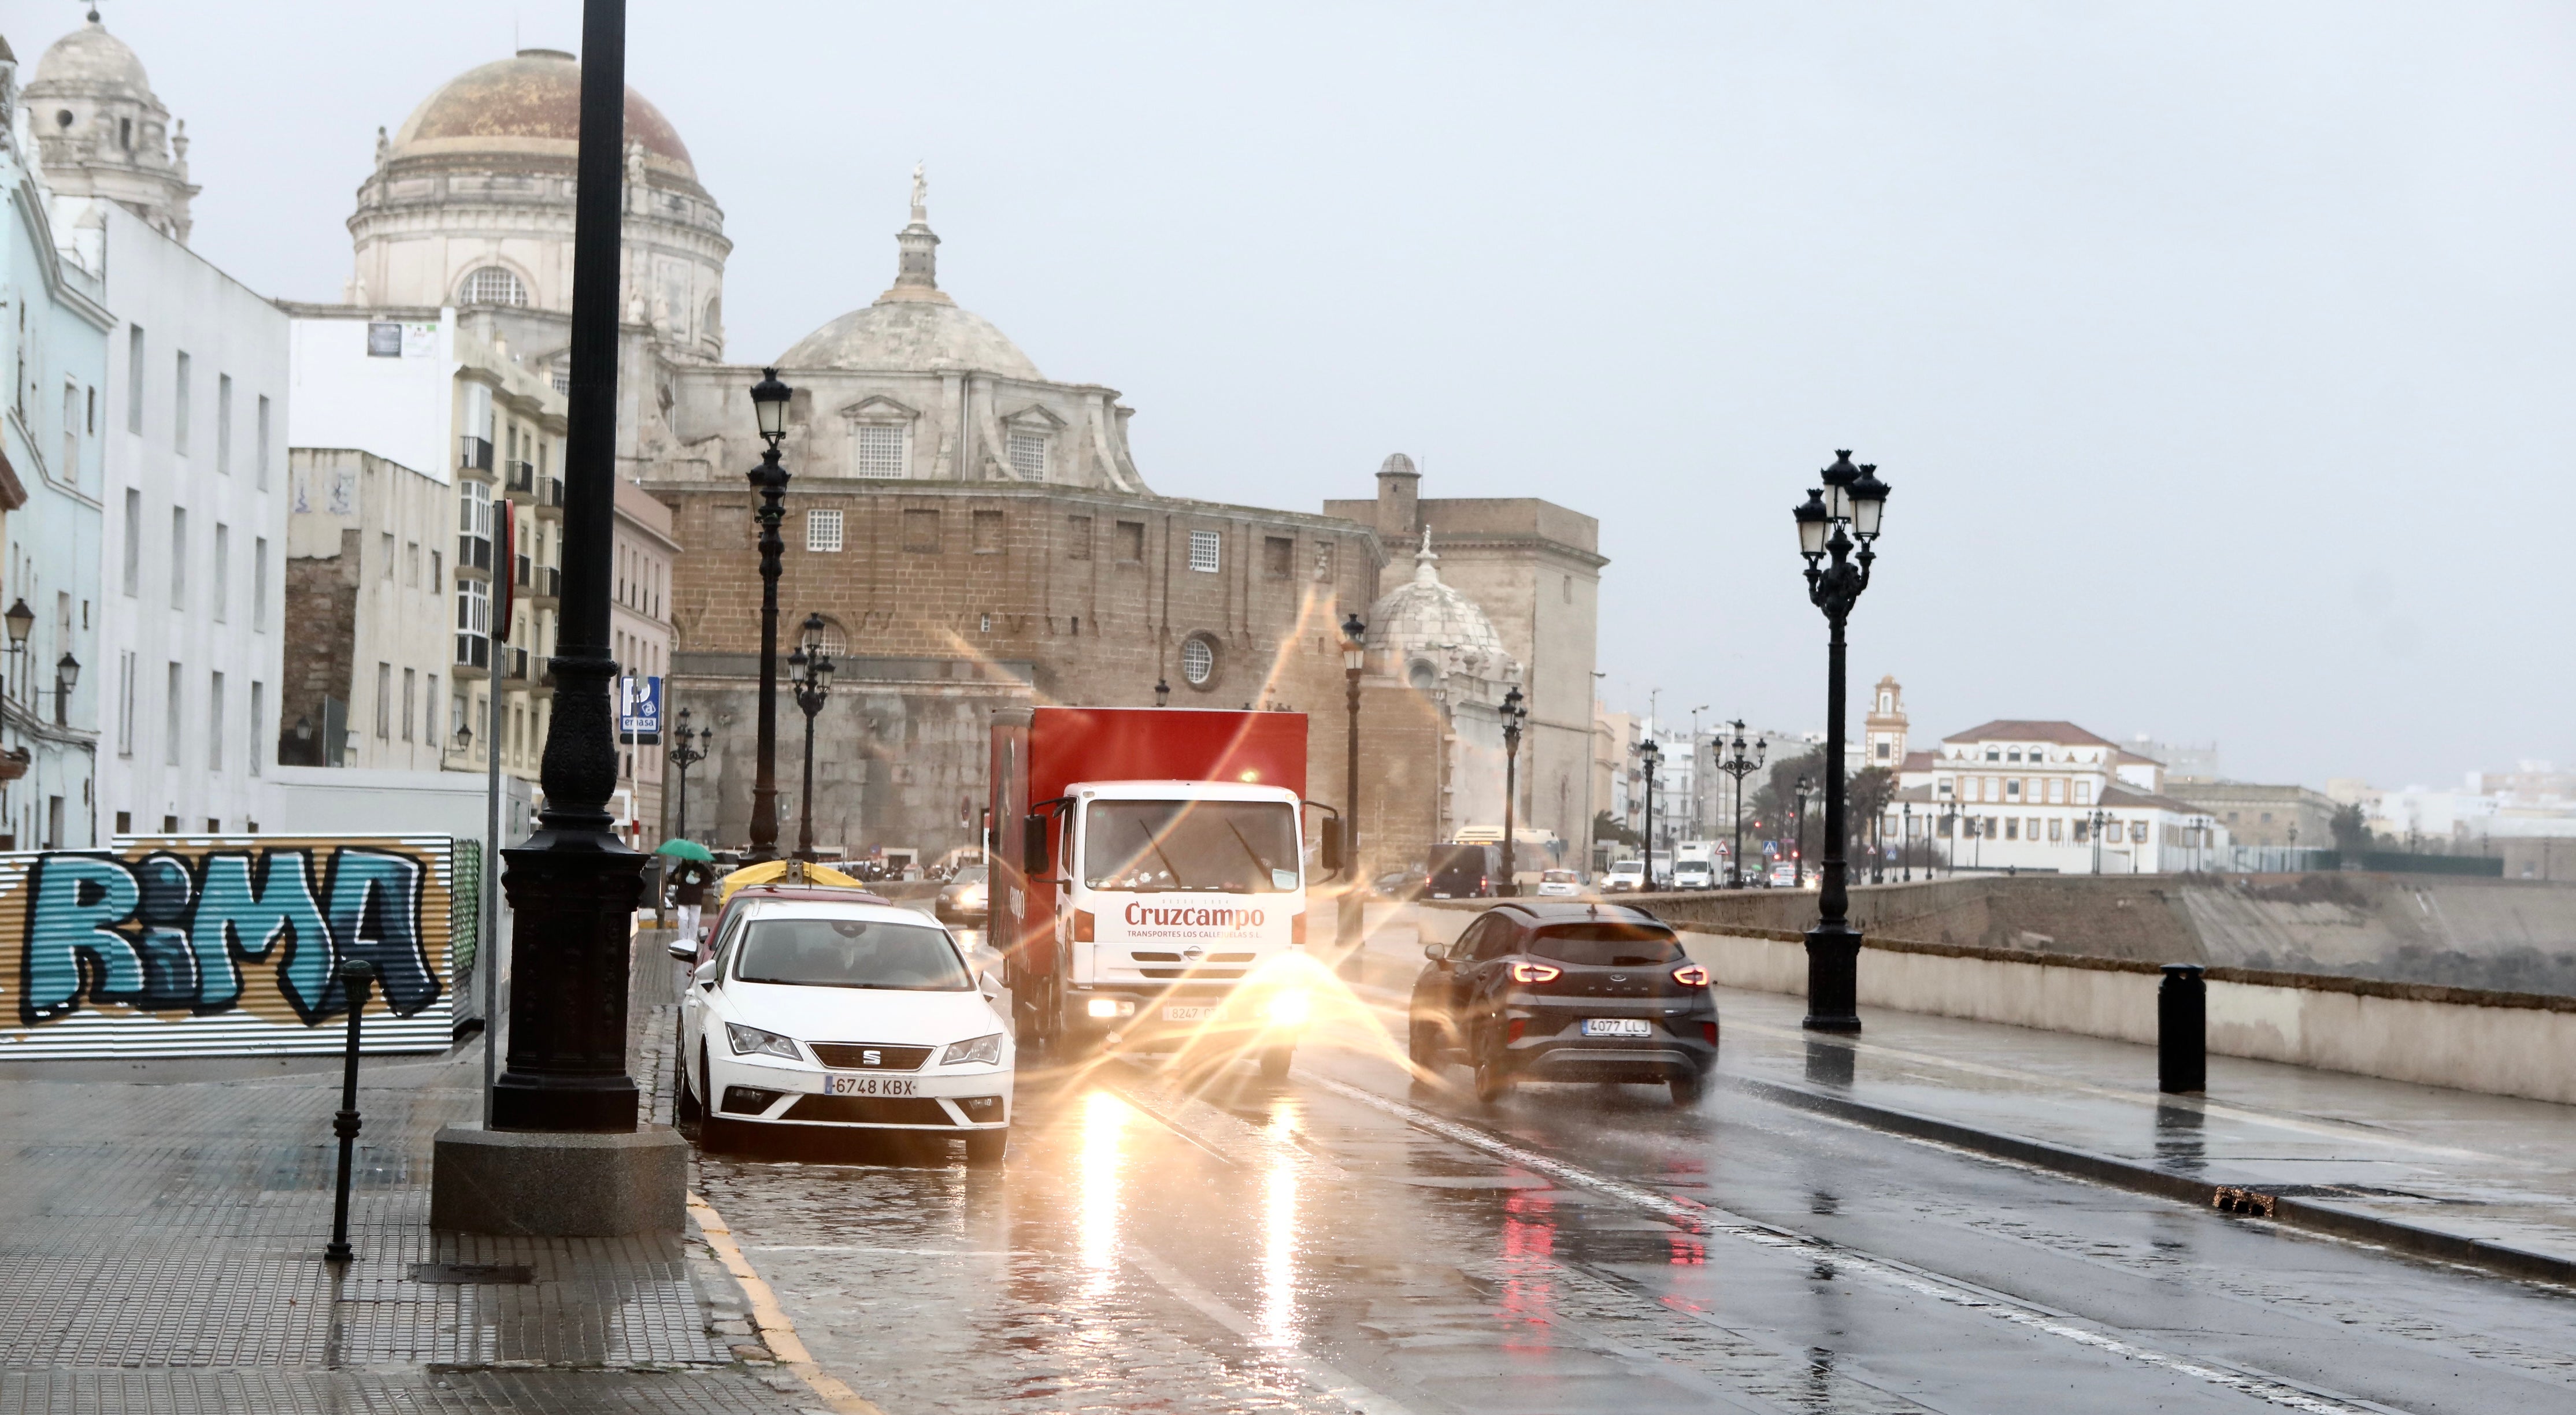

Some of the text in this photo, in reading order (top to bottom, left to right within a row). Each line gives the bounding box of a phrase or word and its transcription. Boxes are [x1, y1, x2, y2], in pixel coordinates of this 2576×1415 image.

[1125, 901, 1265, 930] Cruzcampo
[1172, 1008, 1198, 1019] 8247
[1591, 1021, 1647, 1032] 4077 LLJ
[836, 1078, 913, 1095] 6748 KBX
